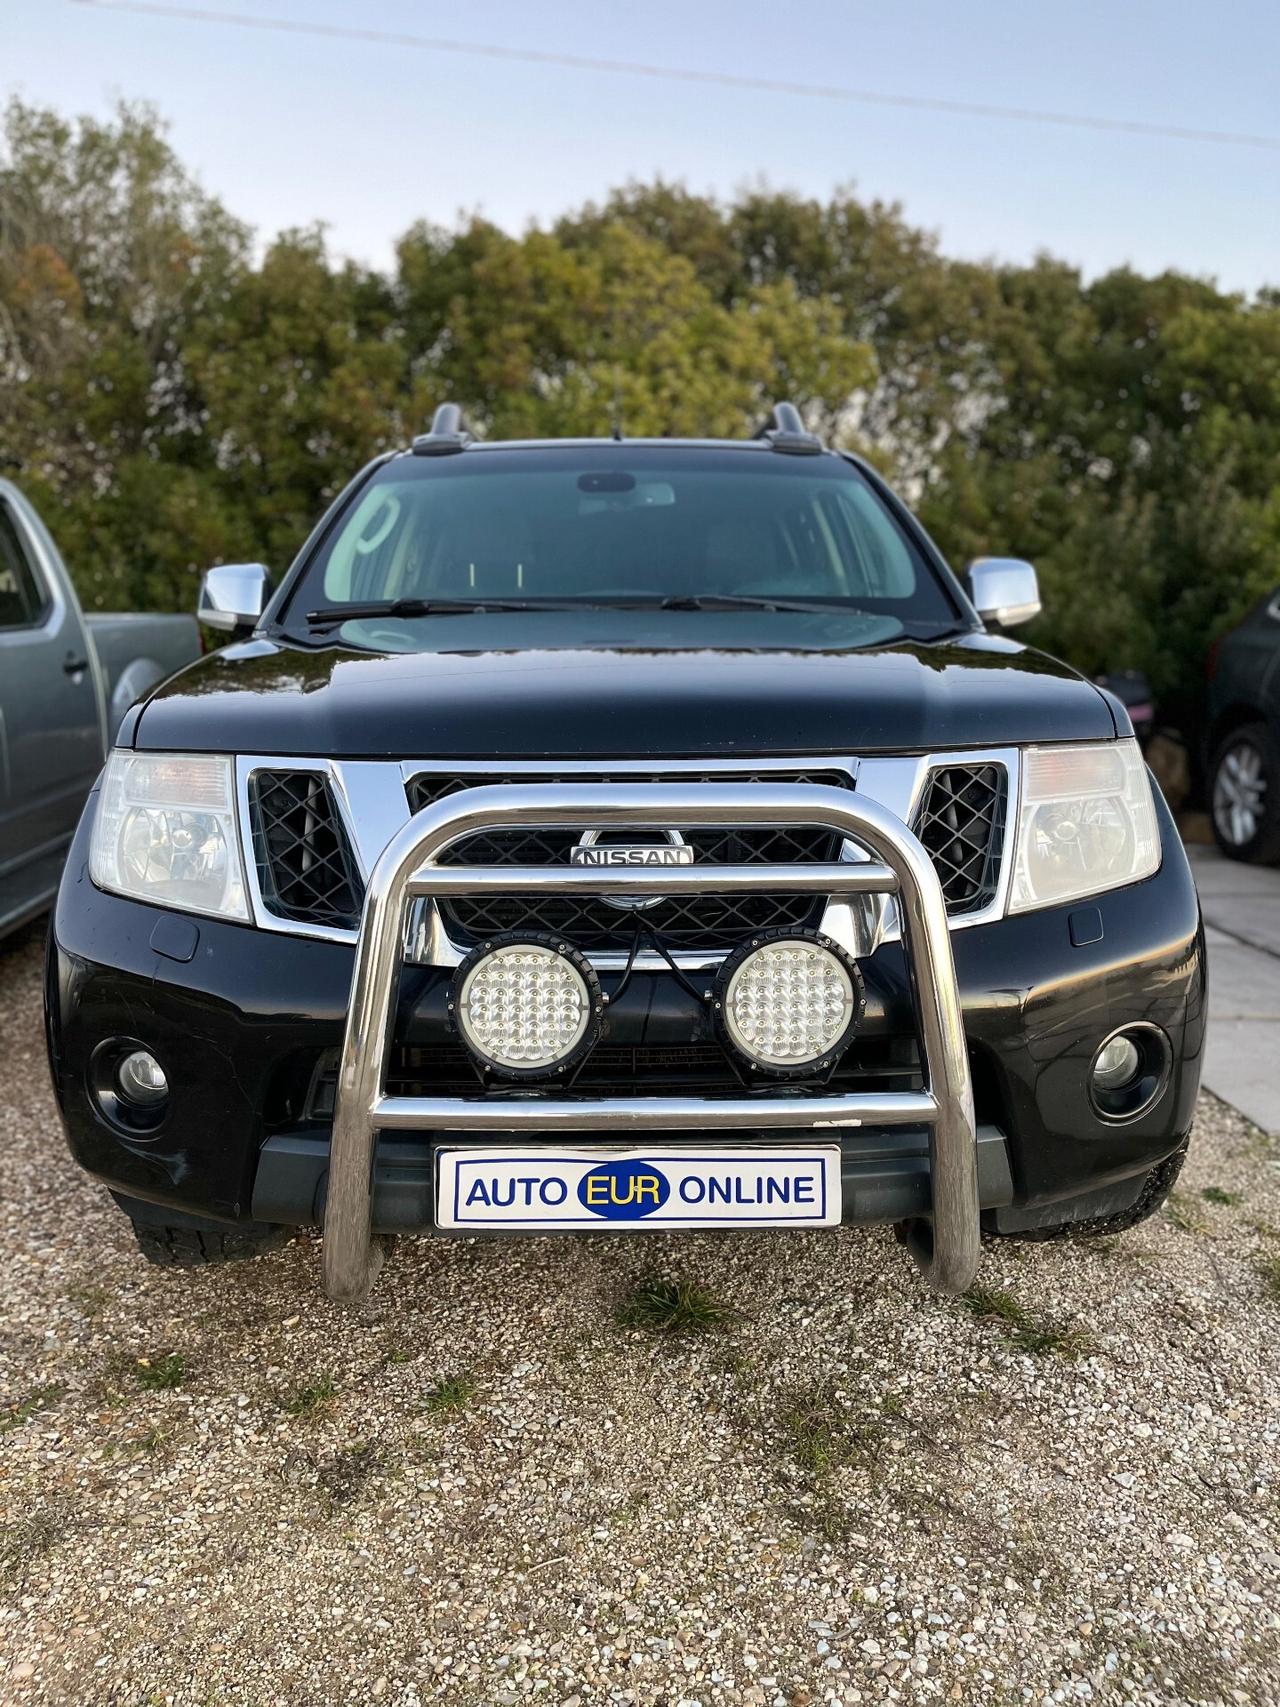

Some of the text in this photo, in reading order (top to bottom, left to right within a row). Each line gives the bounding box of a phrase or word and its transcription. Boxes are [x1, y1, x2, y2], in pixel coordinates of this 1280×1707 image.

[583, 851, 681, 864] NISSAN
[465, 1175, 815, 1207] AUTO EUR ONLINE
